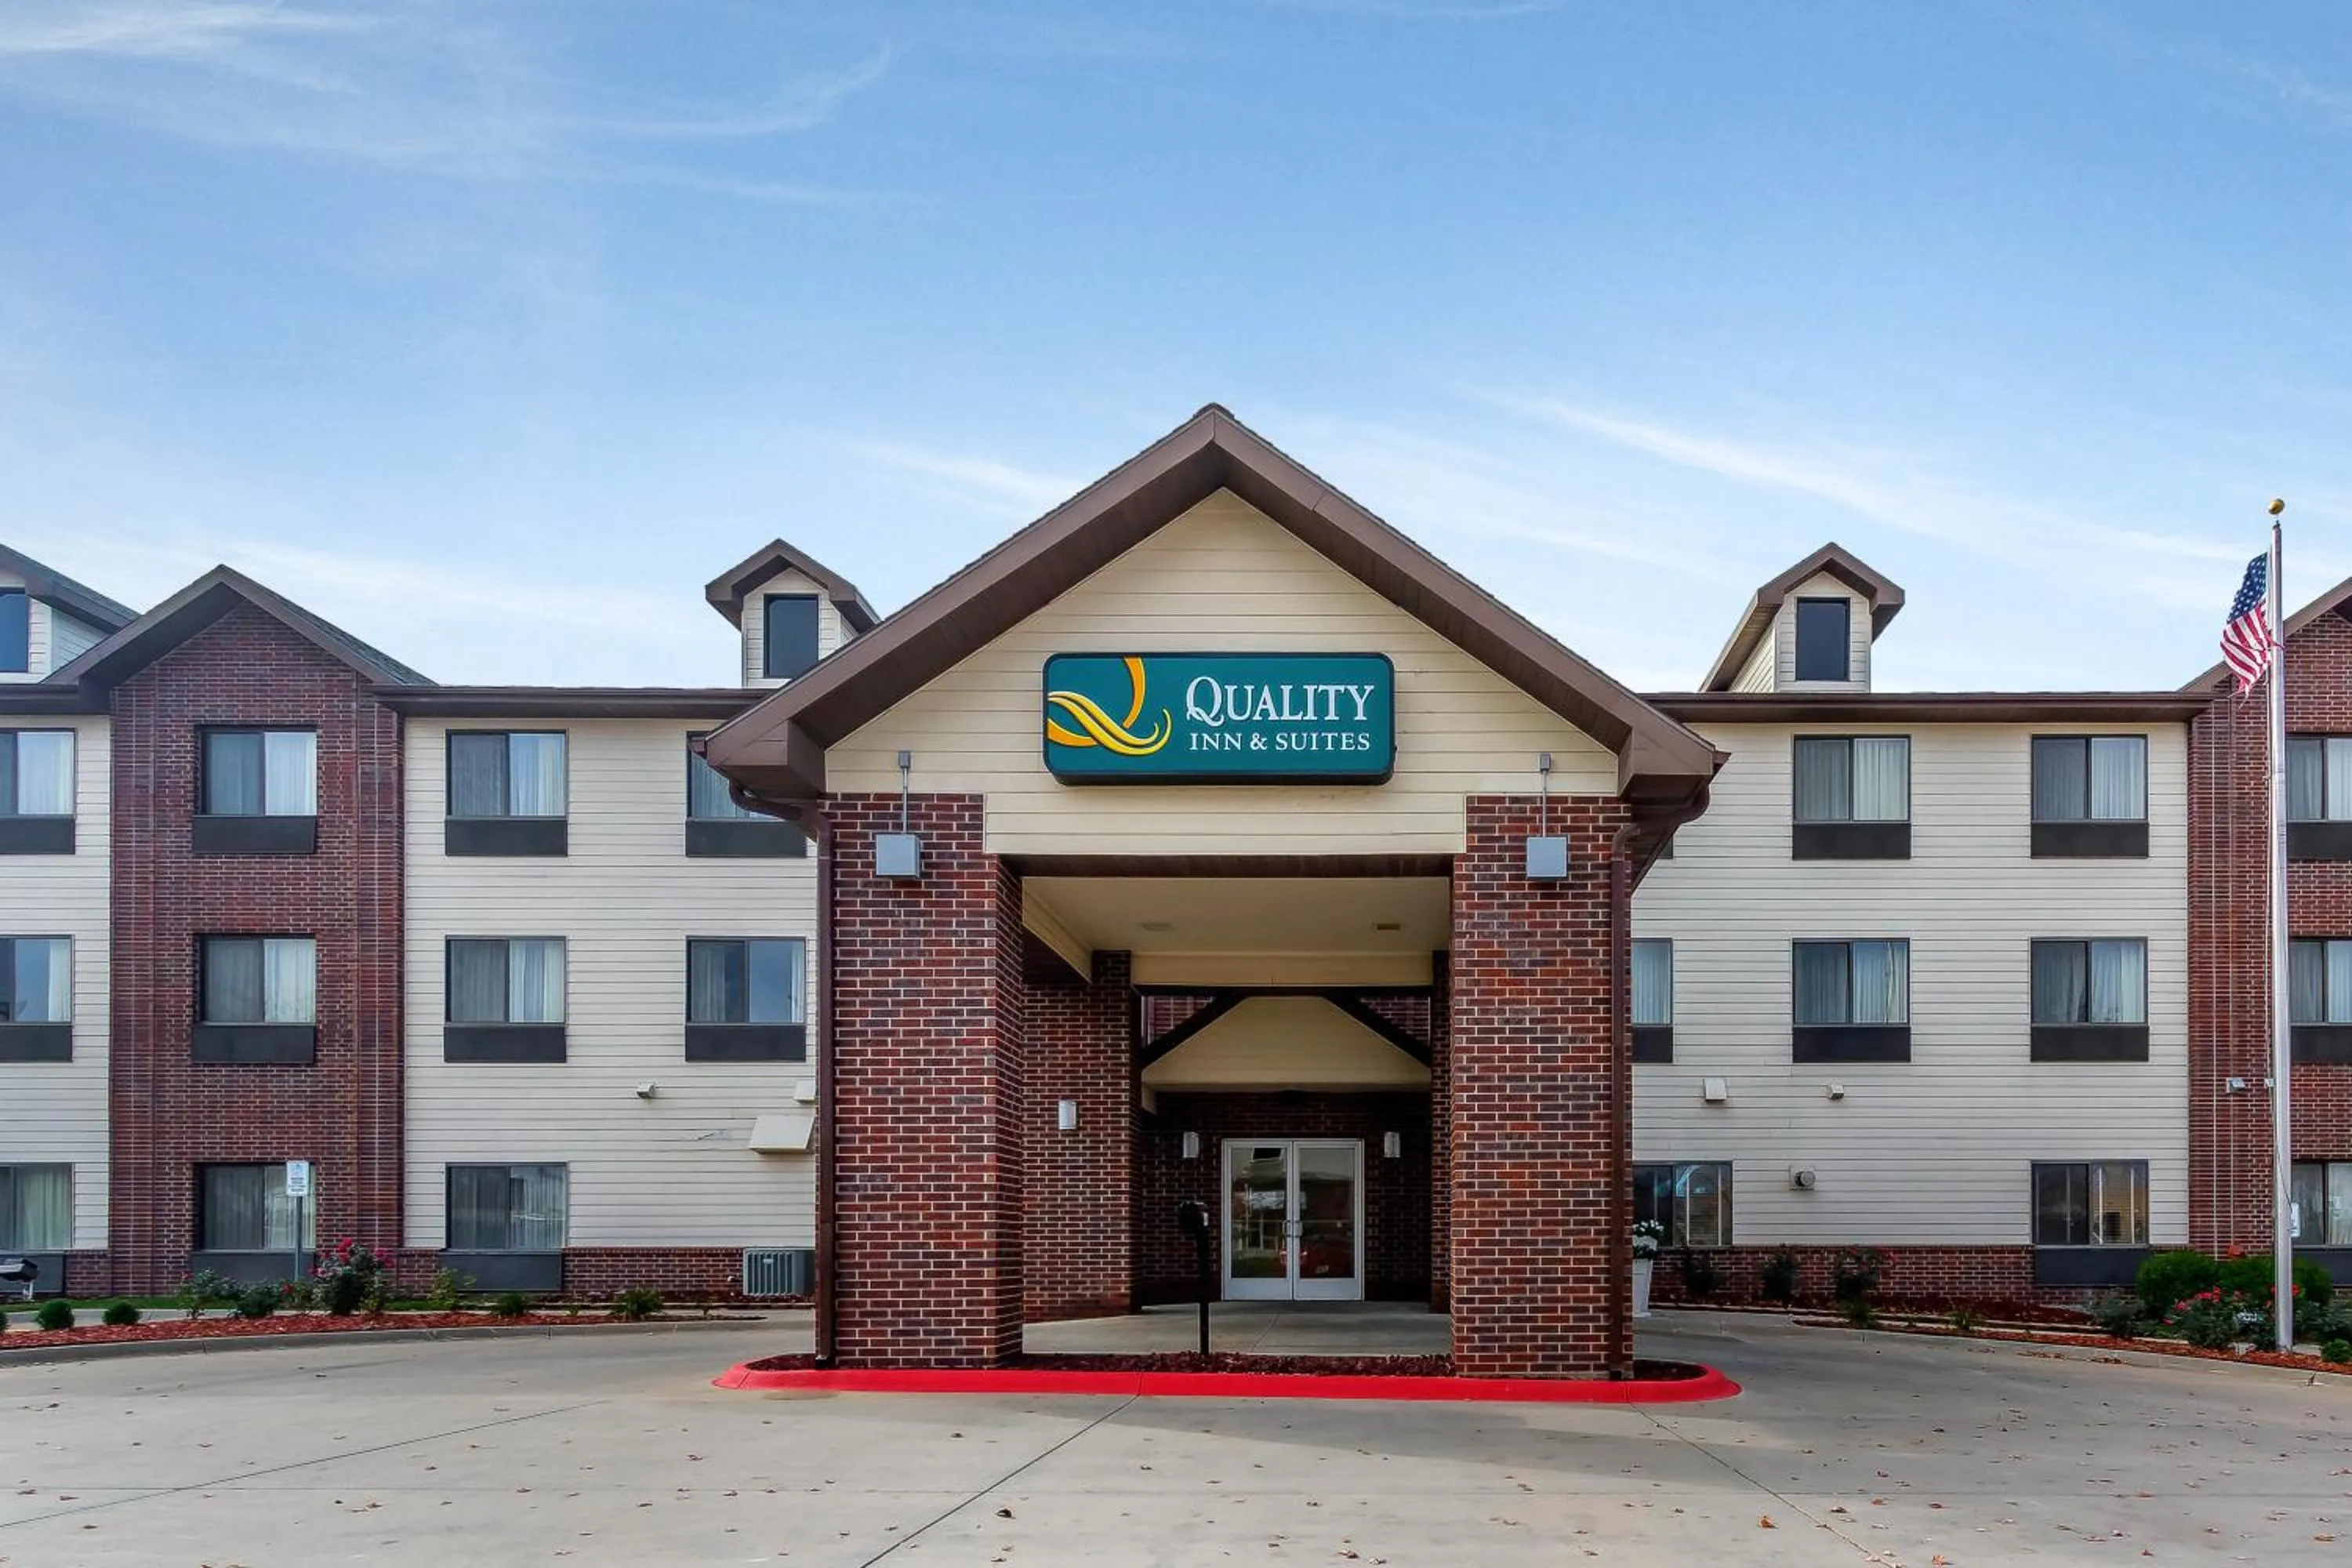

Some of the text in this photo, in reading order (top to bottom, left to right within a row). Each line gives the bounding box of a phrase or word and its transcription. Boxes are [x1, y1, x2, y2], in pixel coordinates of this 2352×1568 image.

[1186, 677, 1374, 727] QUALITY
[1190, 733, 1370, 750] INN & SUITES
